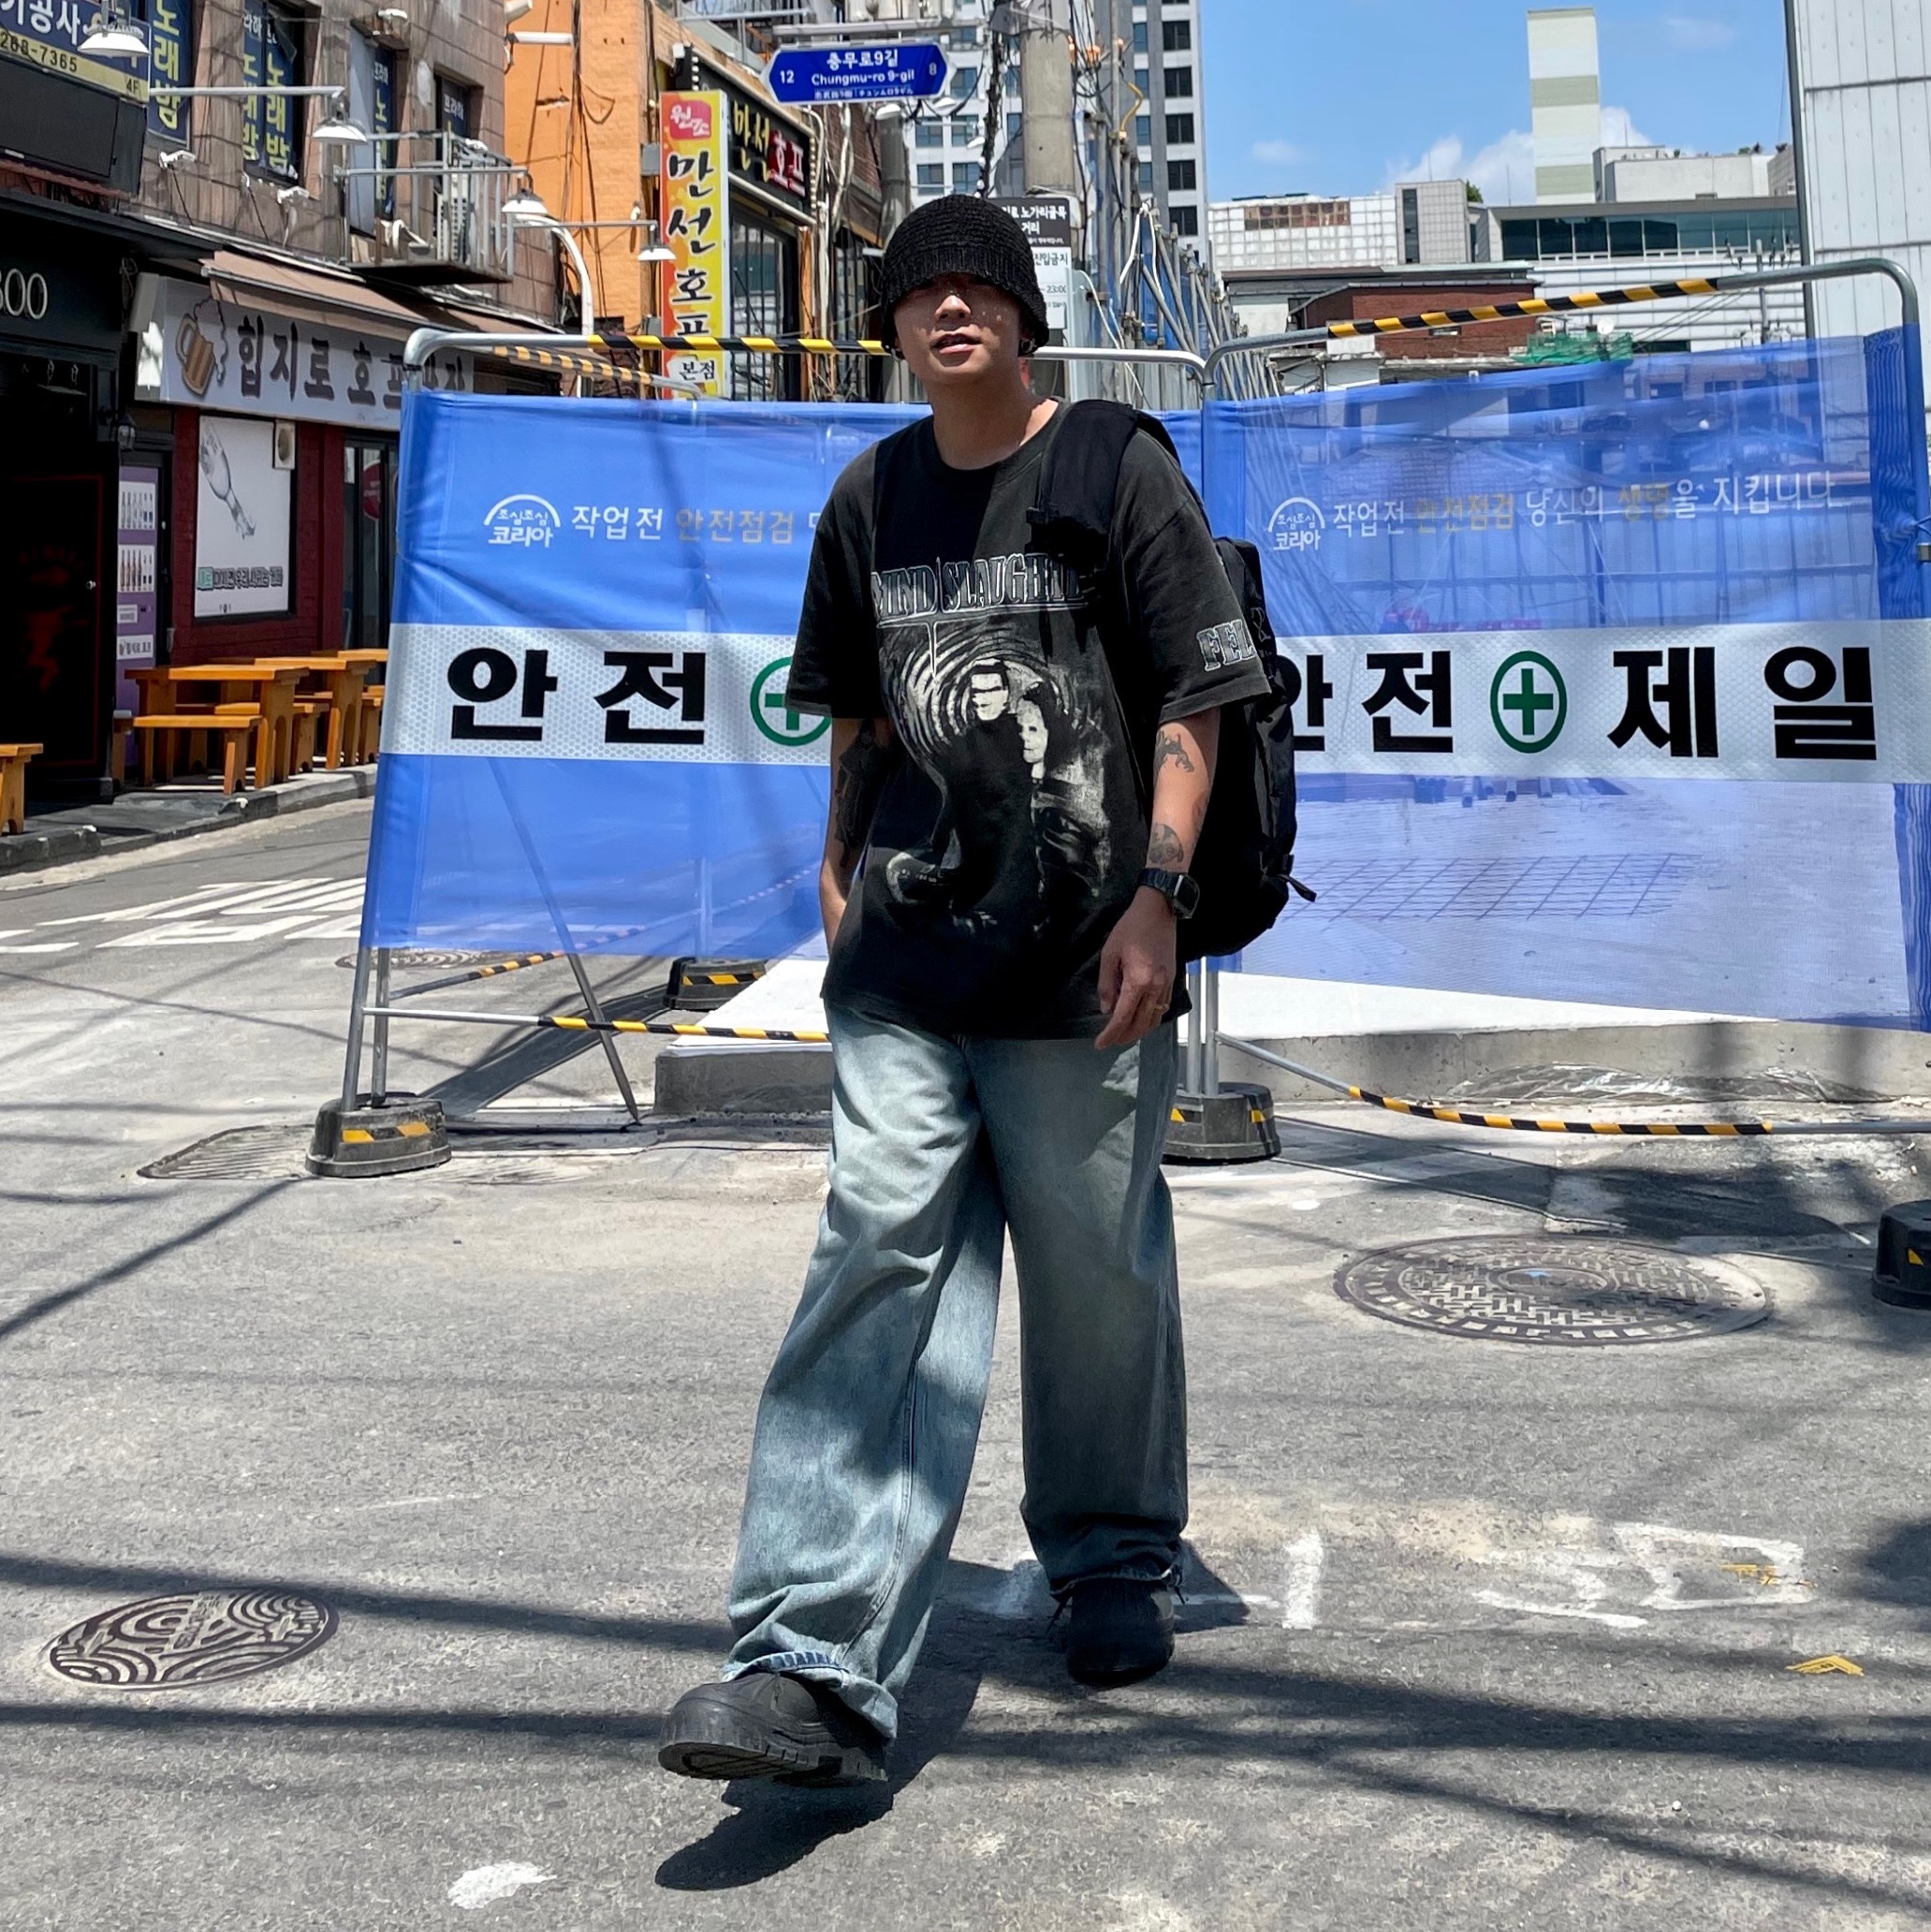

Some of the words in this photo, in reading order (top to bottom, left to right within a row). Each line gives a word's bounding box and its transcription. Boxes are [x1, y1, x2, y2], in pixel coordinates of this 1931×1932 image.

[827, 49, 898, 71] 충무로9길
[929, 62, 937, 76] 8
[125, 79, 139, 93] 4F
[780, 70, 795, 84] 12
[811, 73, 885, 86] Chungmu-ro
[887, 68, 915, 83] 9-gil
[670, 105, 710, 137] 원조
[1021, 220, 1040, 235] 거리
[0, 268, 49, 320] 00
[237, 314, 335, 402] 힙지로
[680, 359, 715, 381] 본점
[1712, 470, 1836, 514] 지킵니다
[497, 508, 549, 526] 조심조심
[677, 508, 794, 545] 안전점검
[1278, 514, 1316, 529] 조심조심
[488, 526, 553, 549] 코리아
[1273, 530, 1321, 551] 코리아
